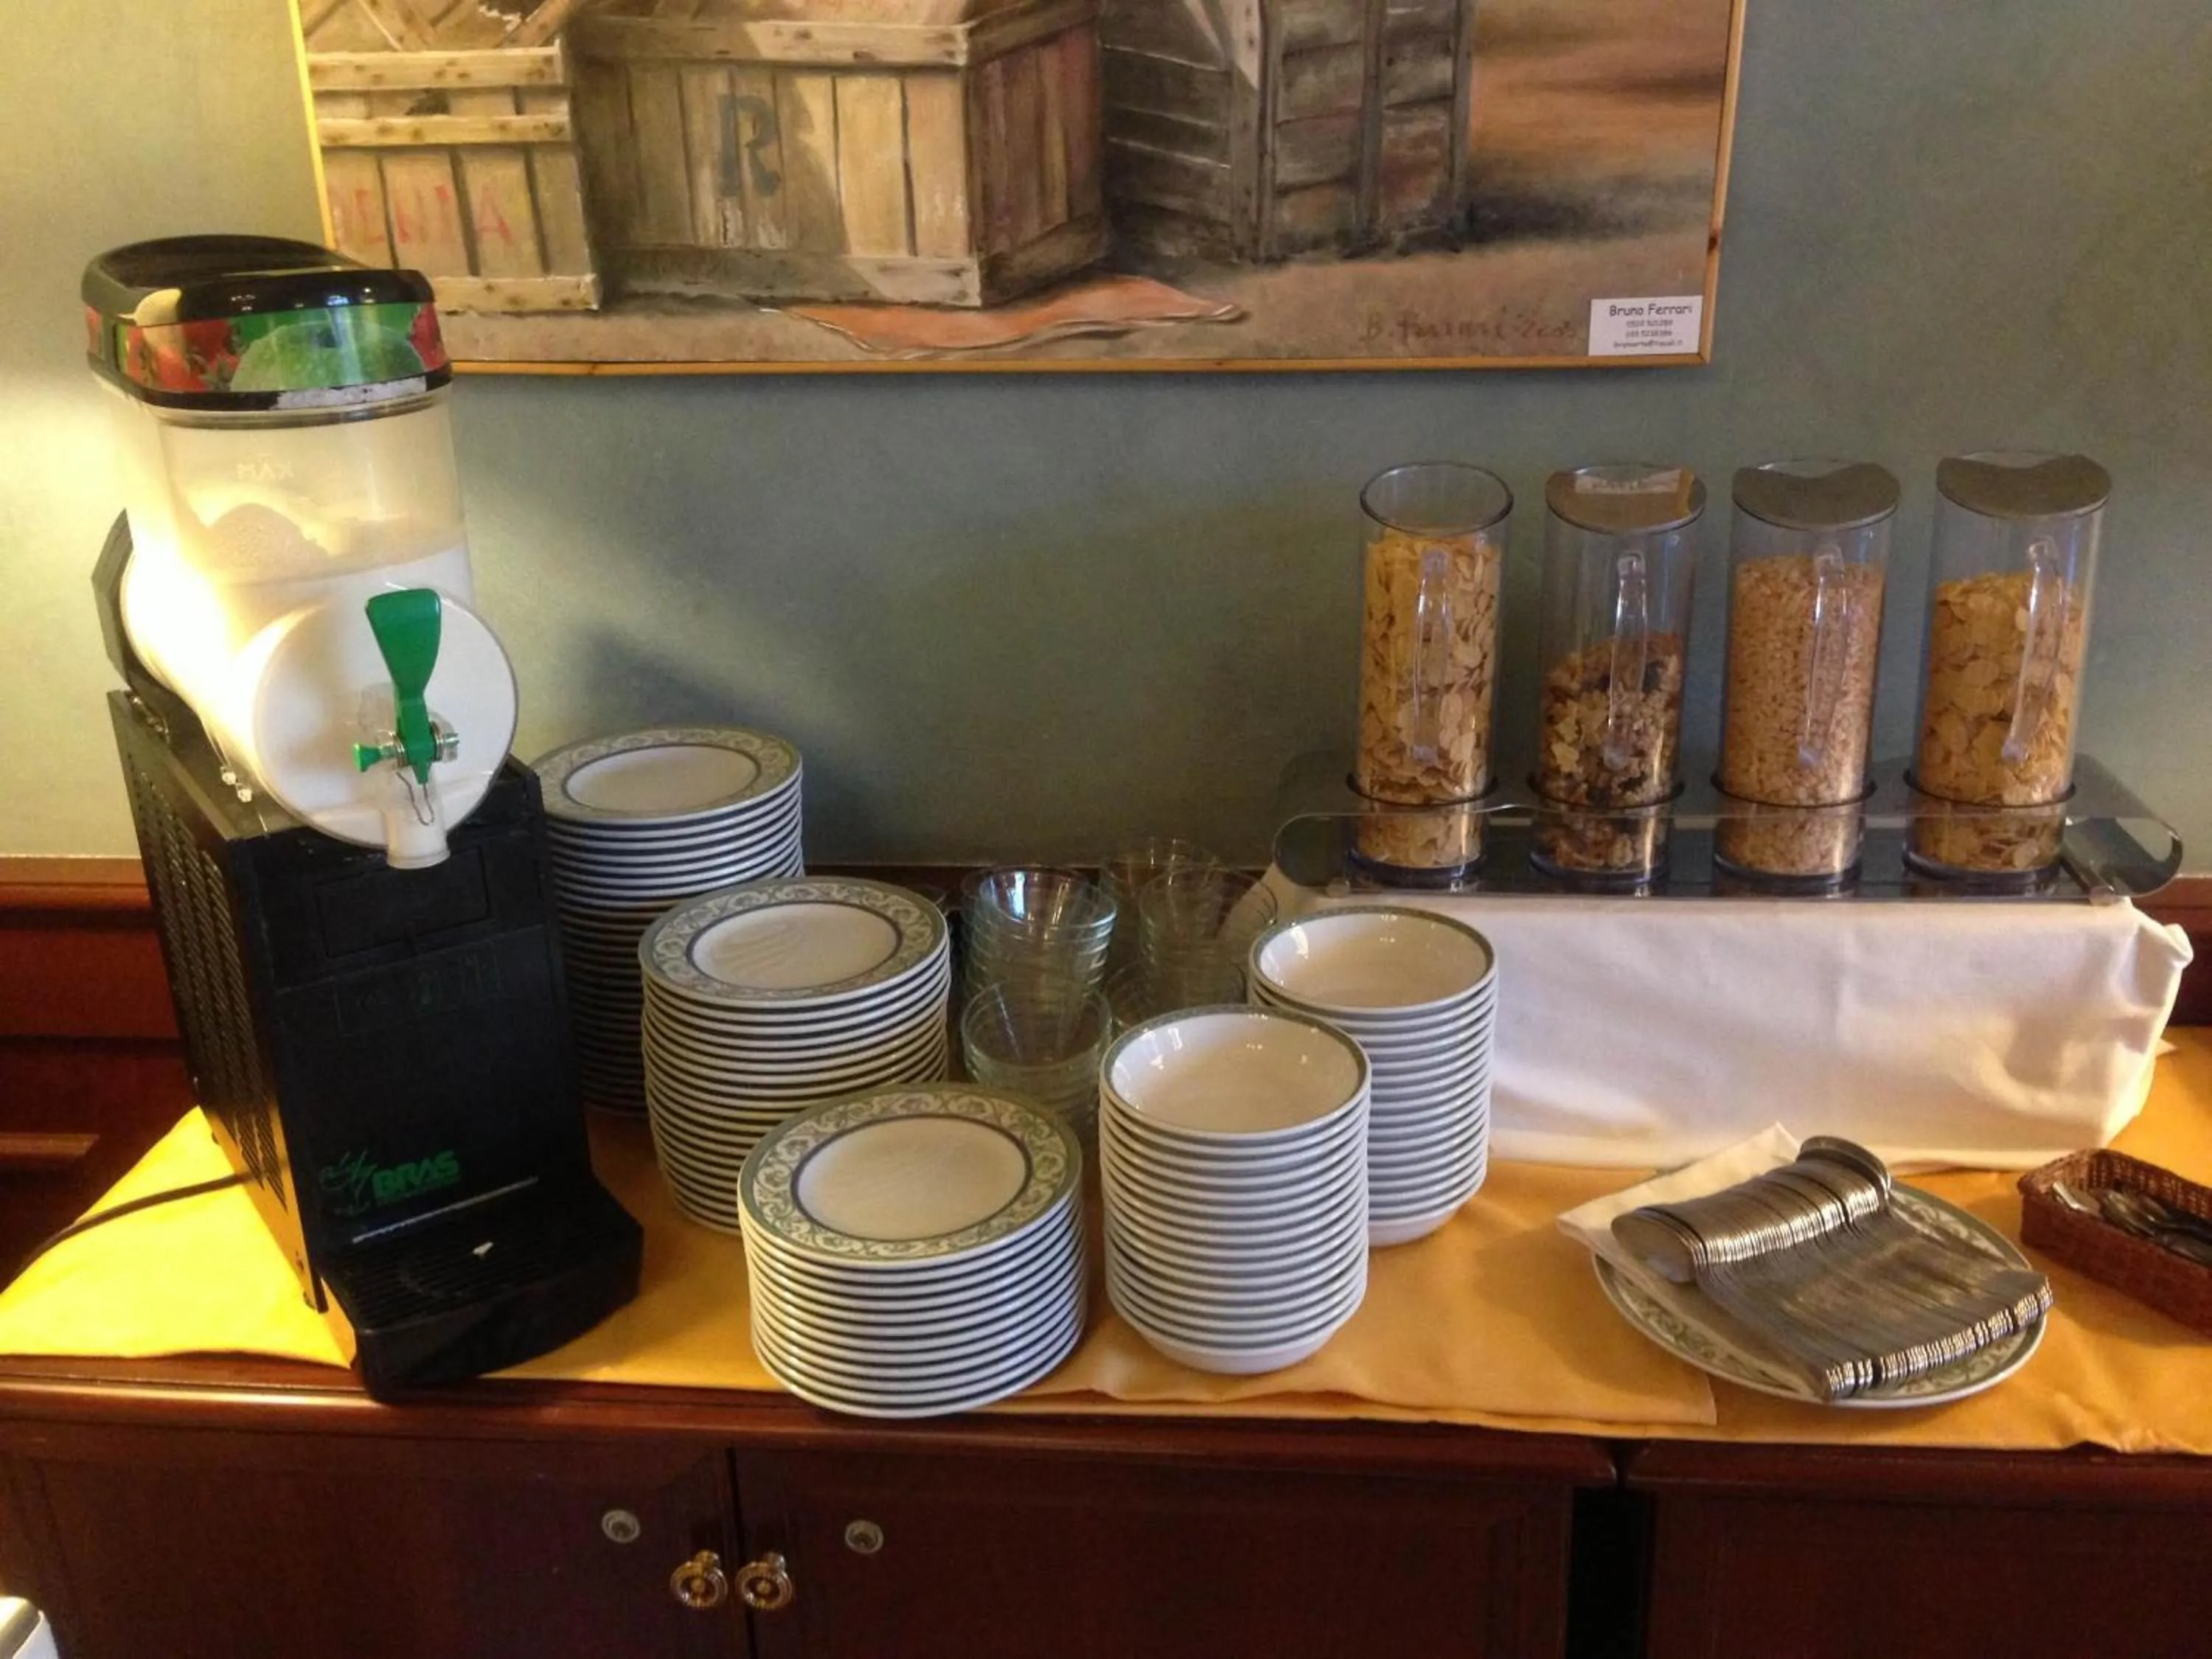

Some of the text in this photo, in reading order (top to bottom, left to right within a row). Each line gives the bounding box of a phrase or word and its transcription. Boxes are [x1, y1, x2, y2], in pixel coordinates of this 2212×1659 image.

[717, 93, 782, 198] R
[1609, 302, 1693, 317] Bruno Ferrari
